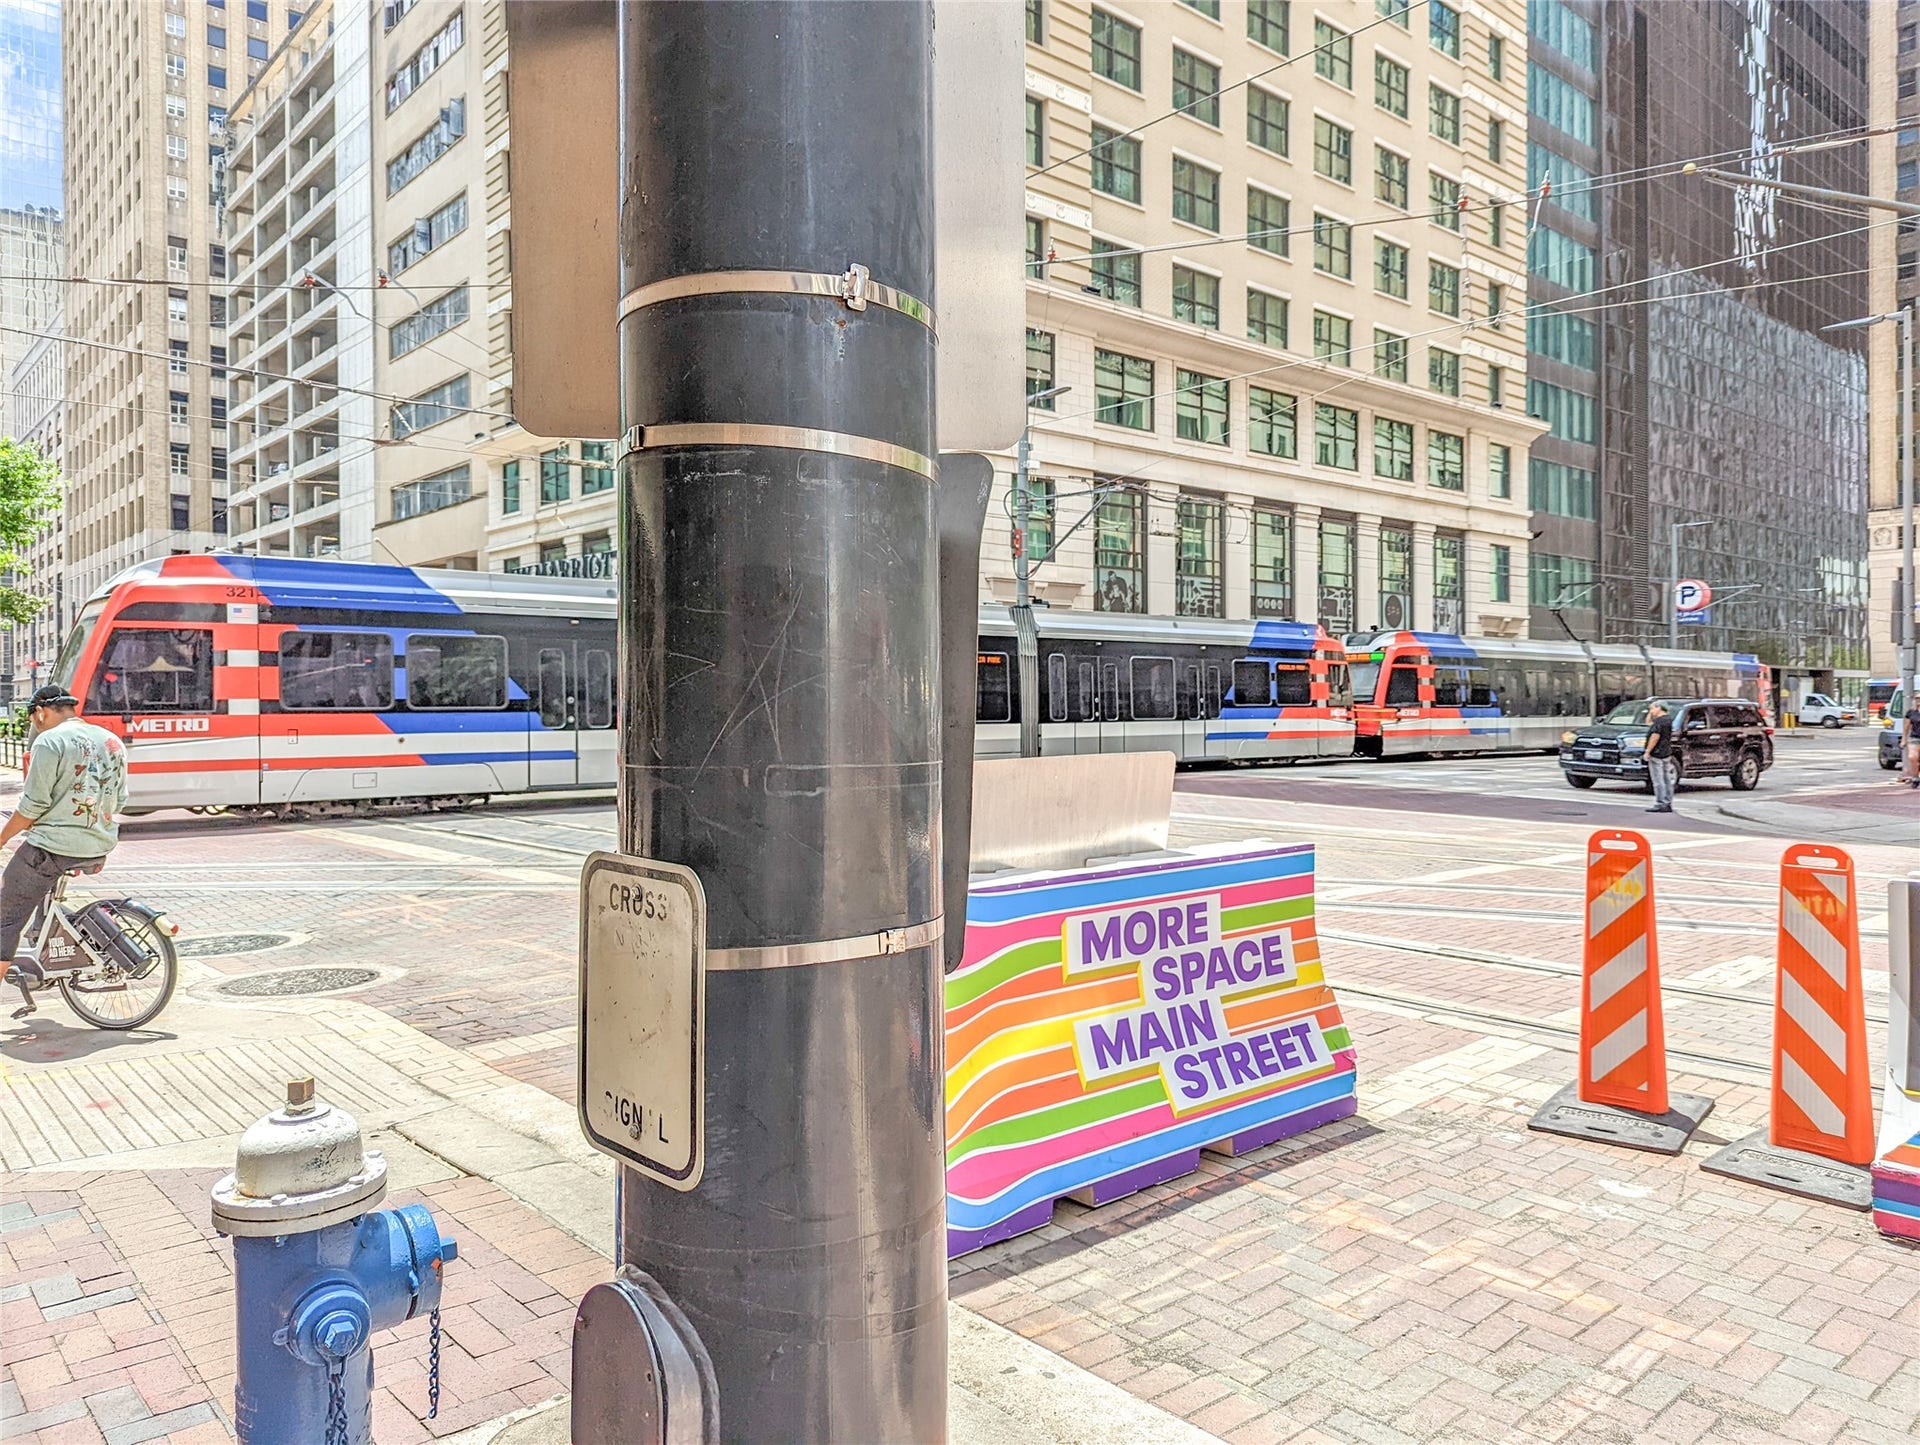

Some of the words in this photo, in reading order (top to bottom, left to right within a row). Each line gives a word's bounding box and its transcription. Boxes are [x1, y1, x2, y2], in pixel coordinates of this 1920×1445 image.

[226, 587, 254, 598] 321
[1681, 586, 1696, 604] P
[126, 718, 210, 733] METRO
[609, 883, 668, 921] CROSS
[58, 945, 76, 957] HERE
[1081, 901, 1208, 965] MORE
[1152, 935, 1285, 1001] SPACE
[1089, 999, 1217, 1070] MAIN
[1173, 1022, 1318, 1099] STREET
